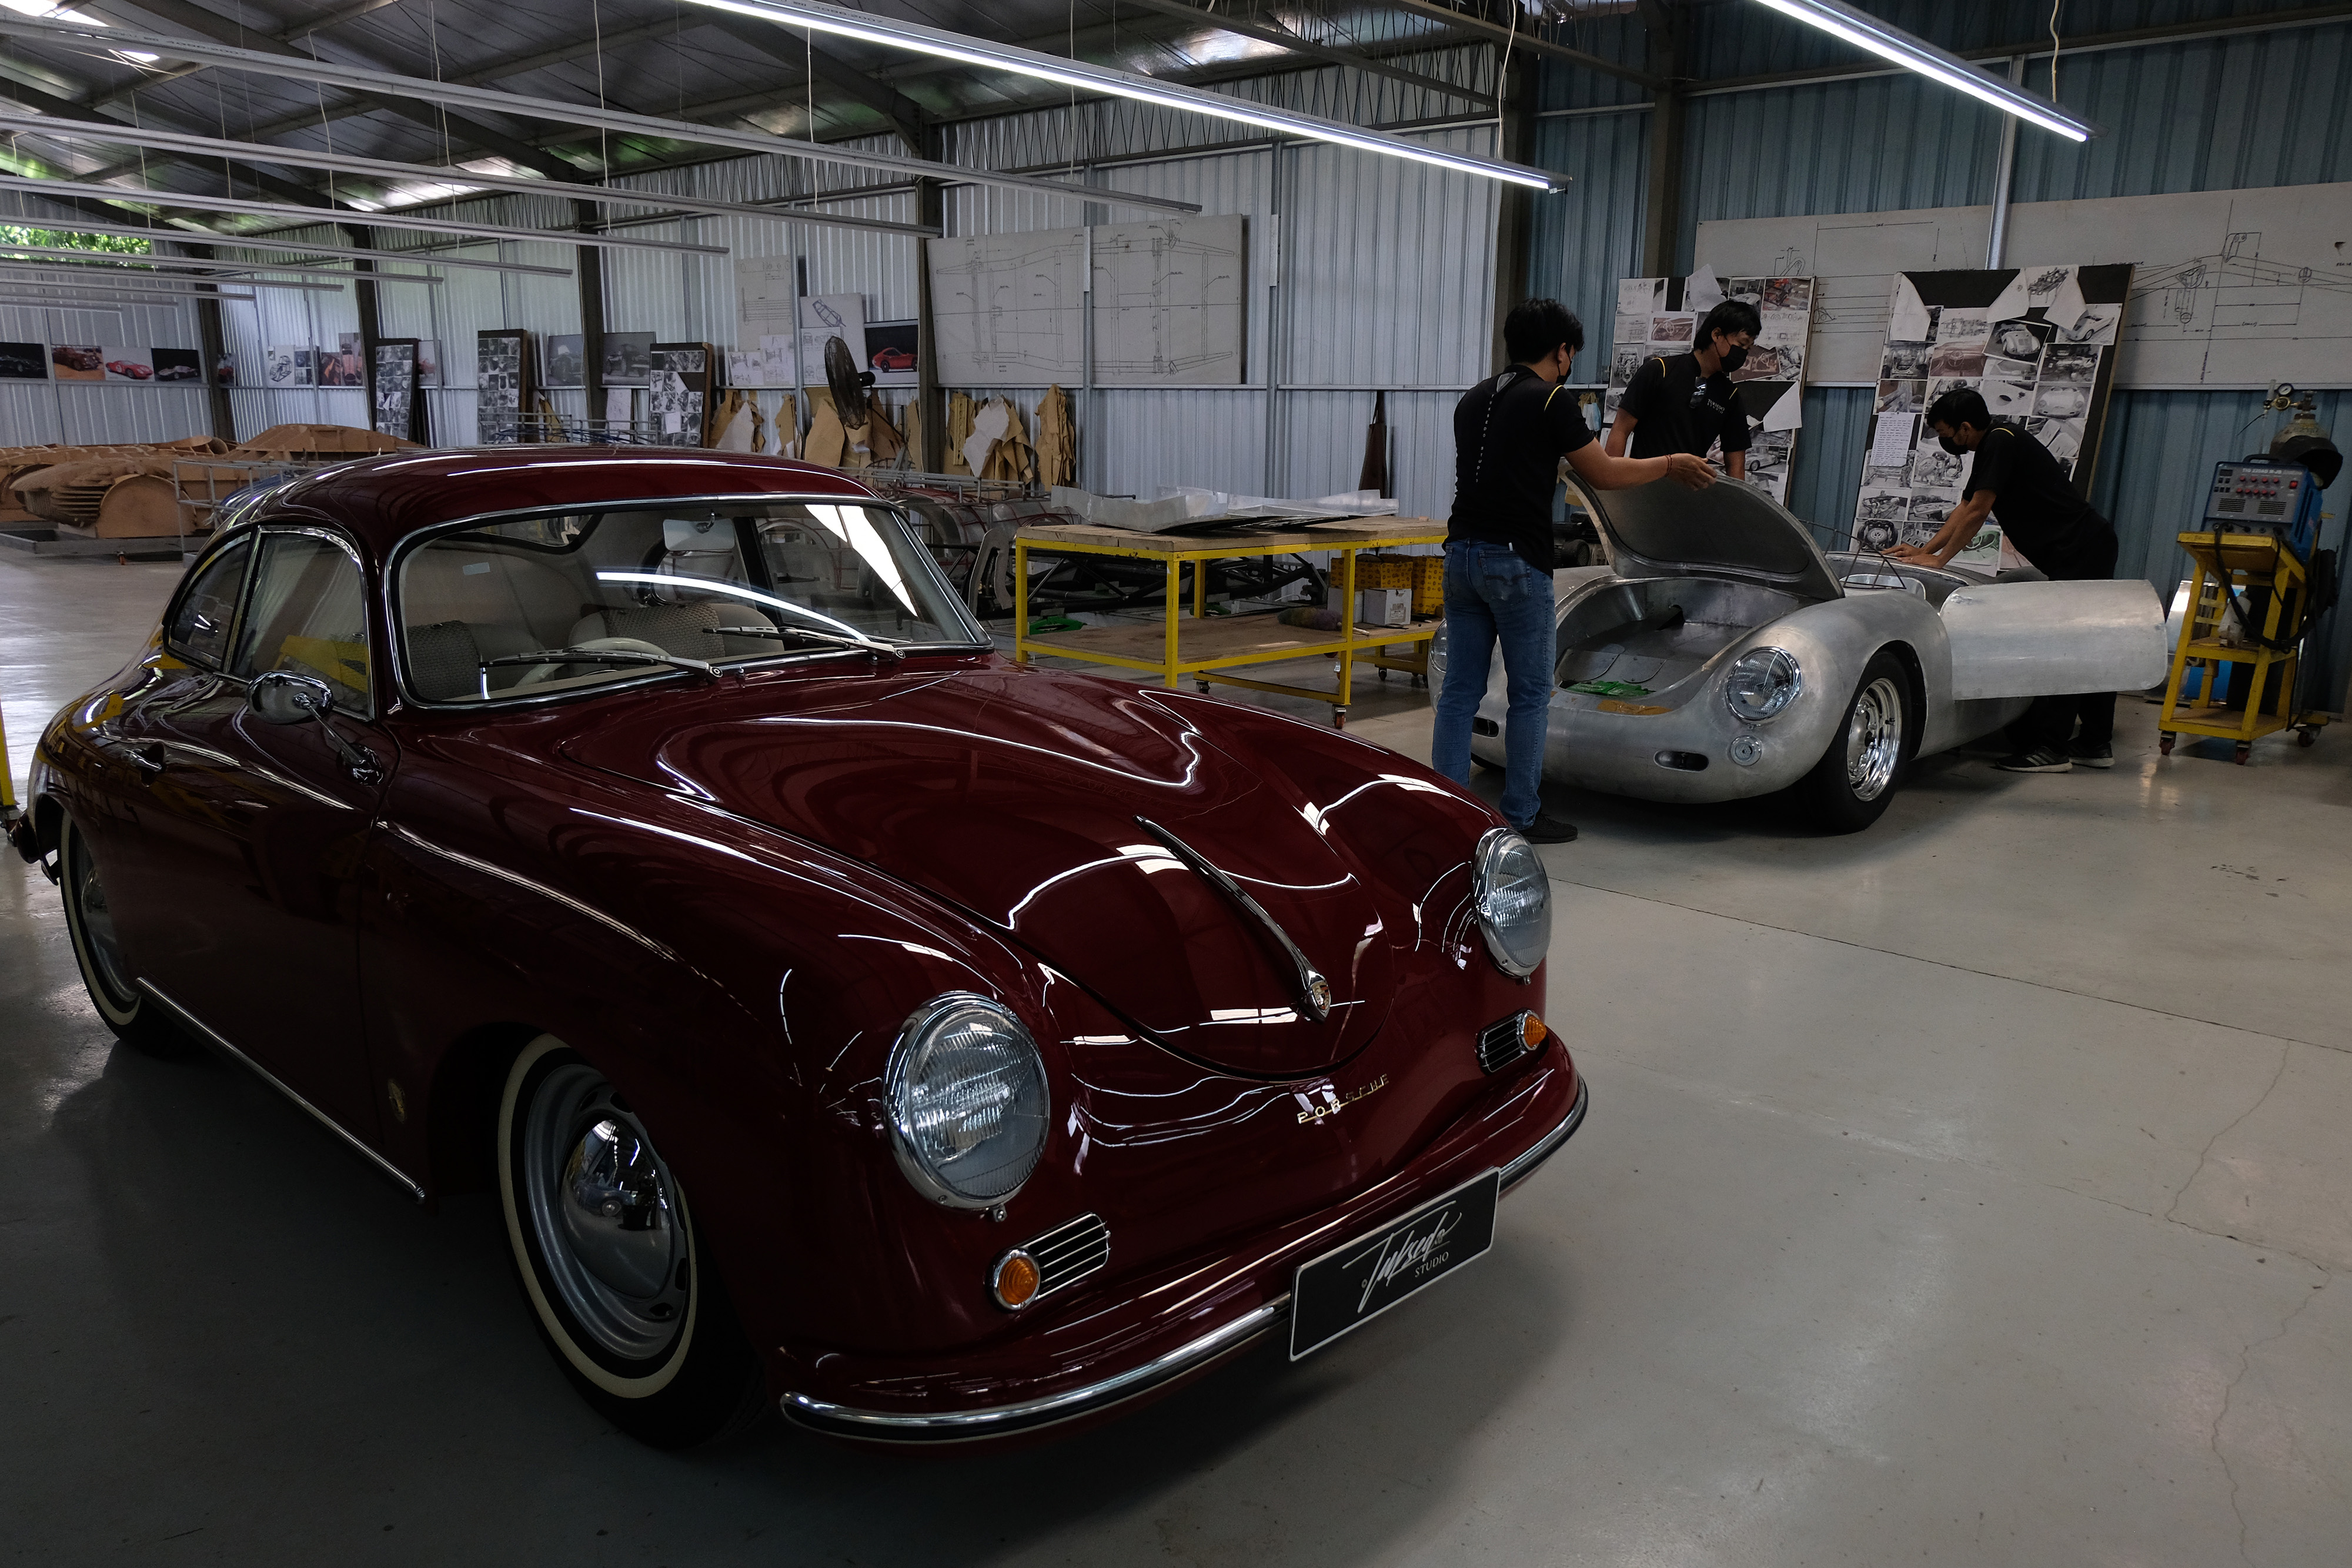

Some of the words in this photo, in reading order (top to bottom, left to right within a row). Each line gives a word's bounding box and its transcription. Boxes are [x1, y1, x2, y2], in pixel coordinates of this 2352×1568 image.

[1475, 446, 1484, 483] STUDIO
[1297, 1074, 1389, 1124] PORSCHE
[1414, 1251, 1449, 1278] STUDIO
